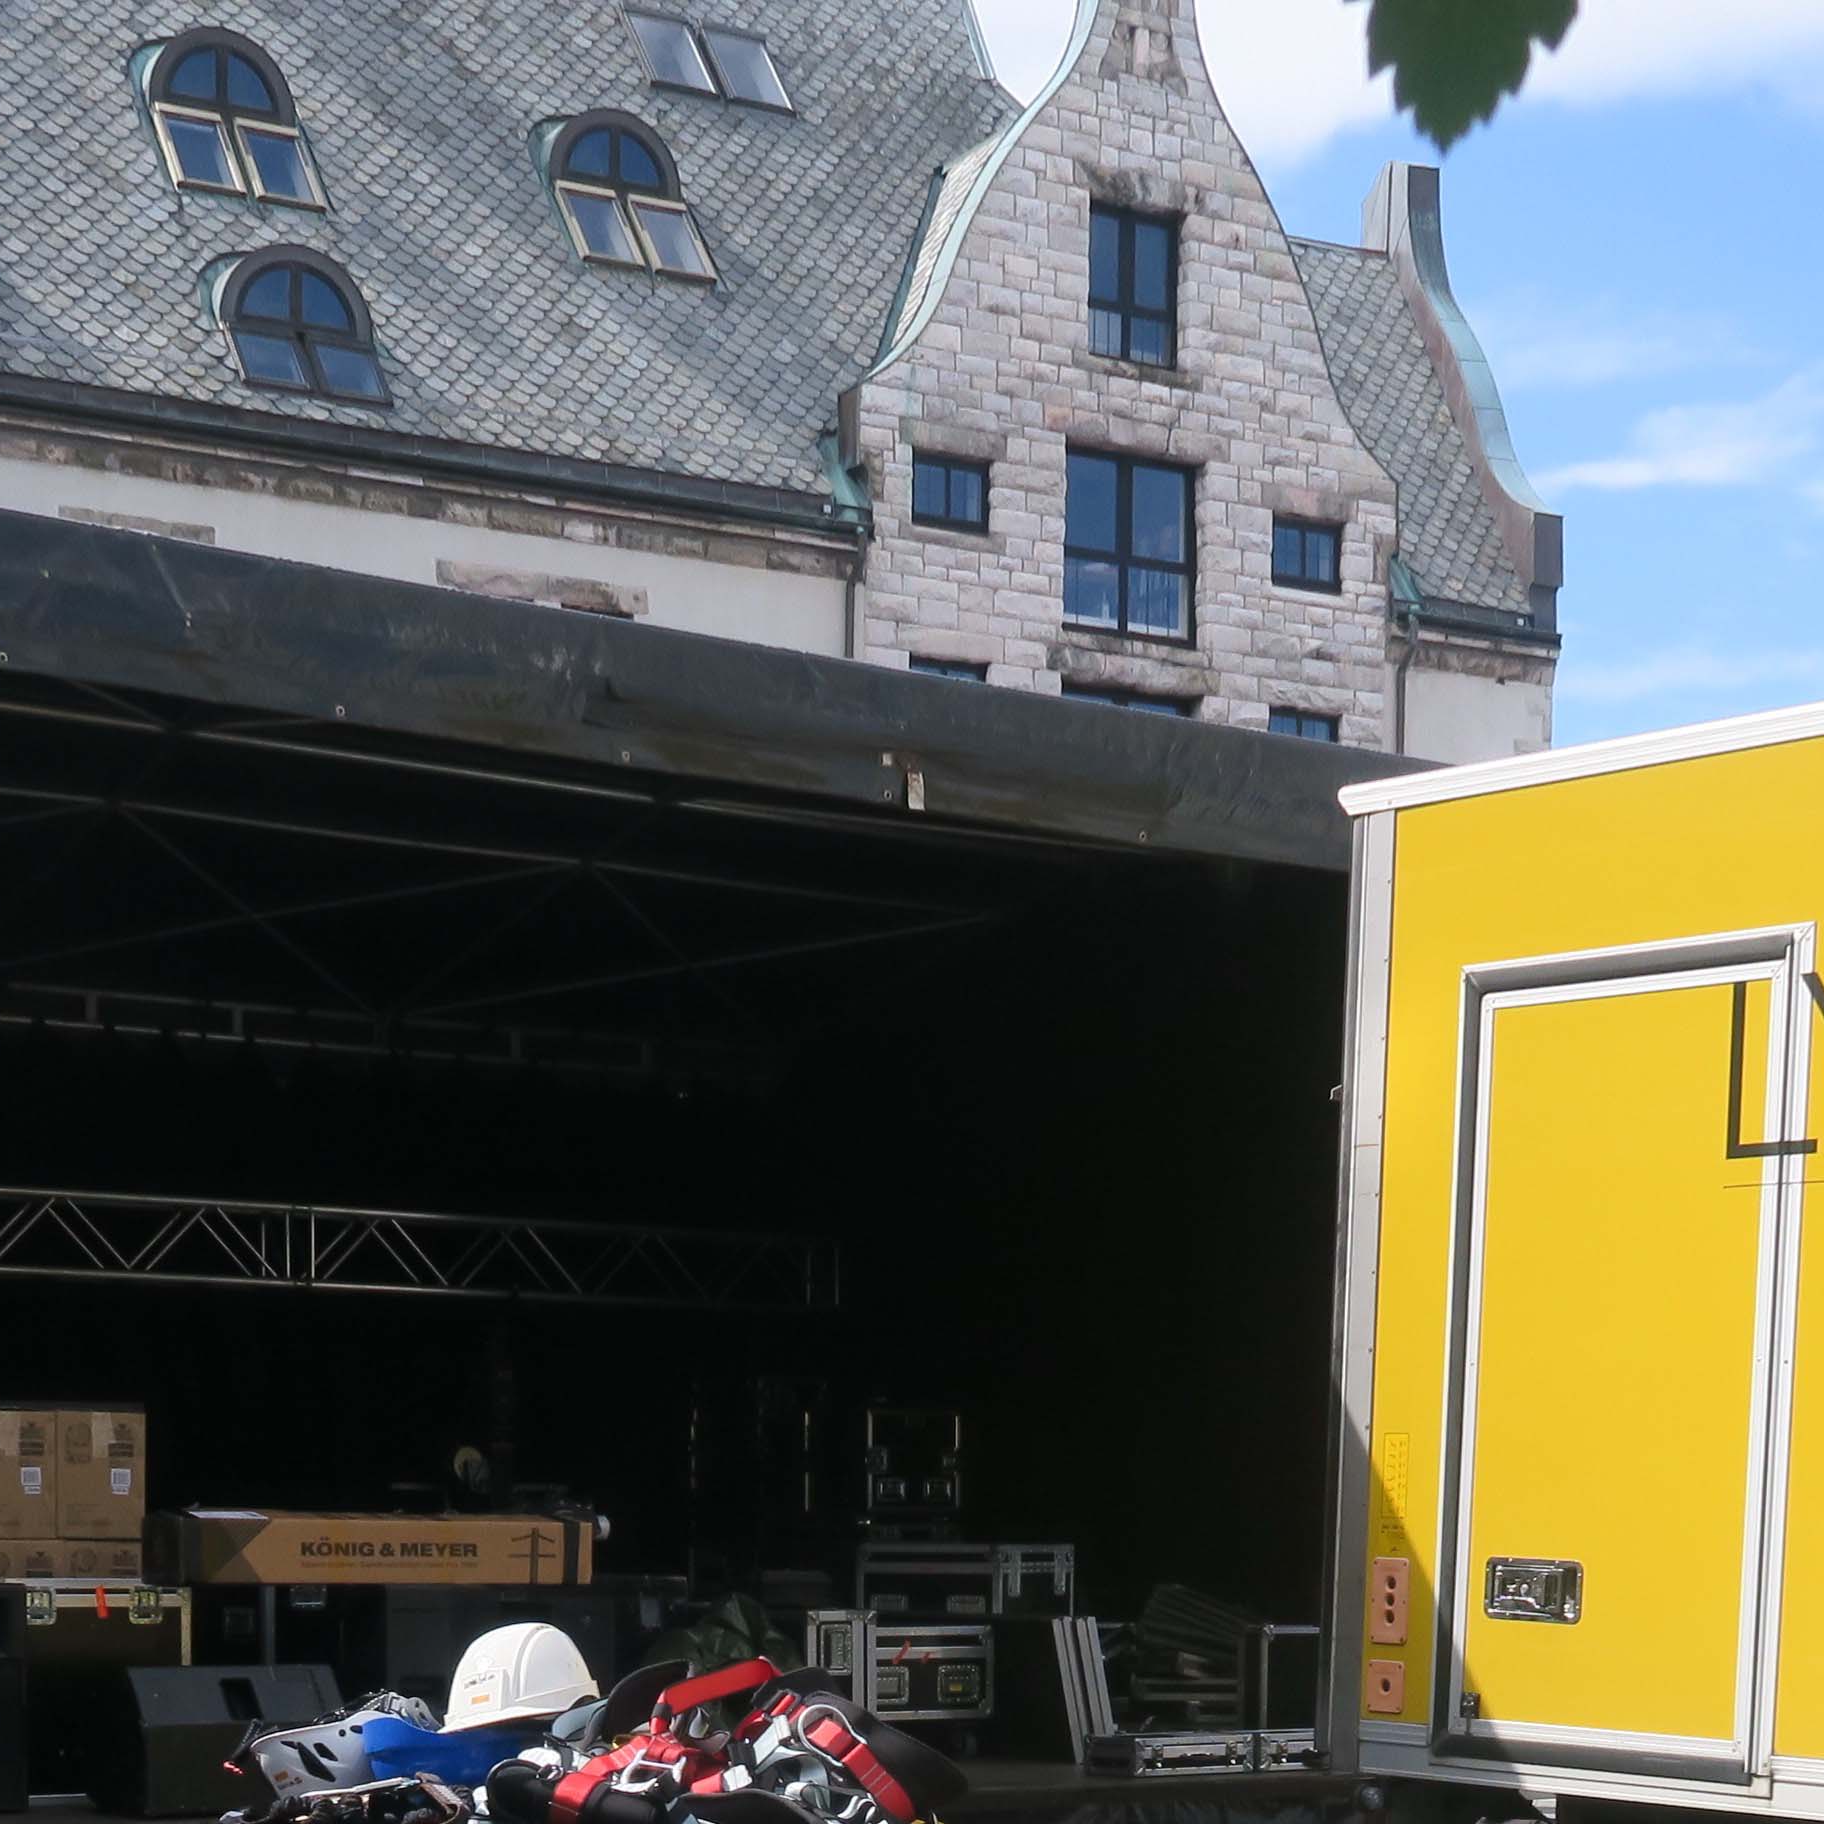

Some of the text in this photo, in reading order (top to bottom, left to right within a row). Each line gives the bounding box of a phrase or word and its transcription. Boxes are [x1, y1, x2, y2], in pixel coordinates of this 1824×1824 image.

[300, 1536, 479, 1557] KÖNIG & MEYER
